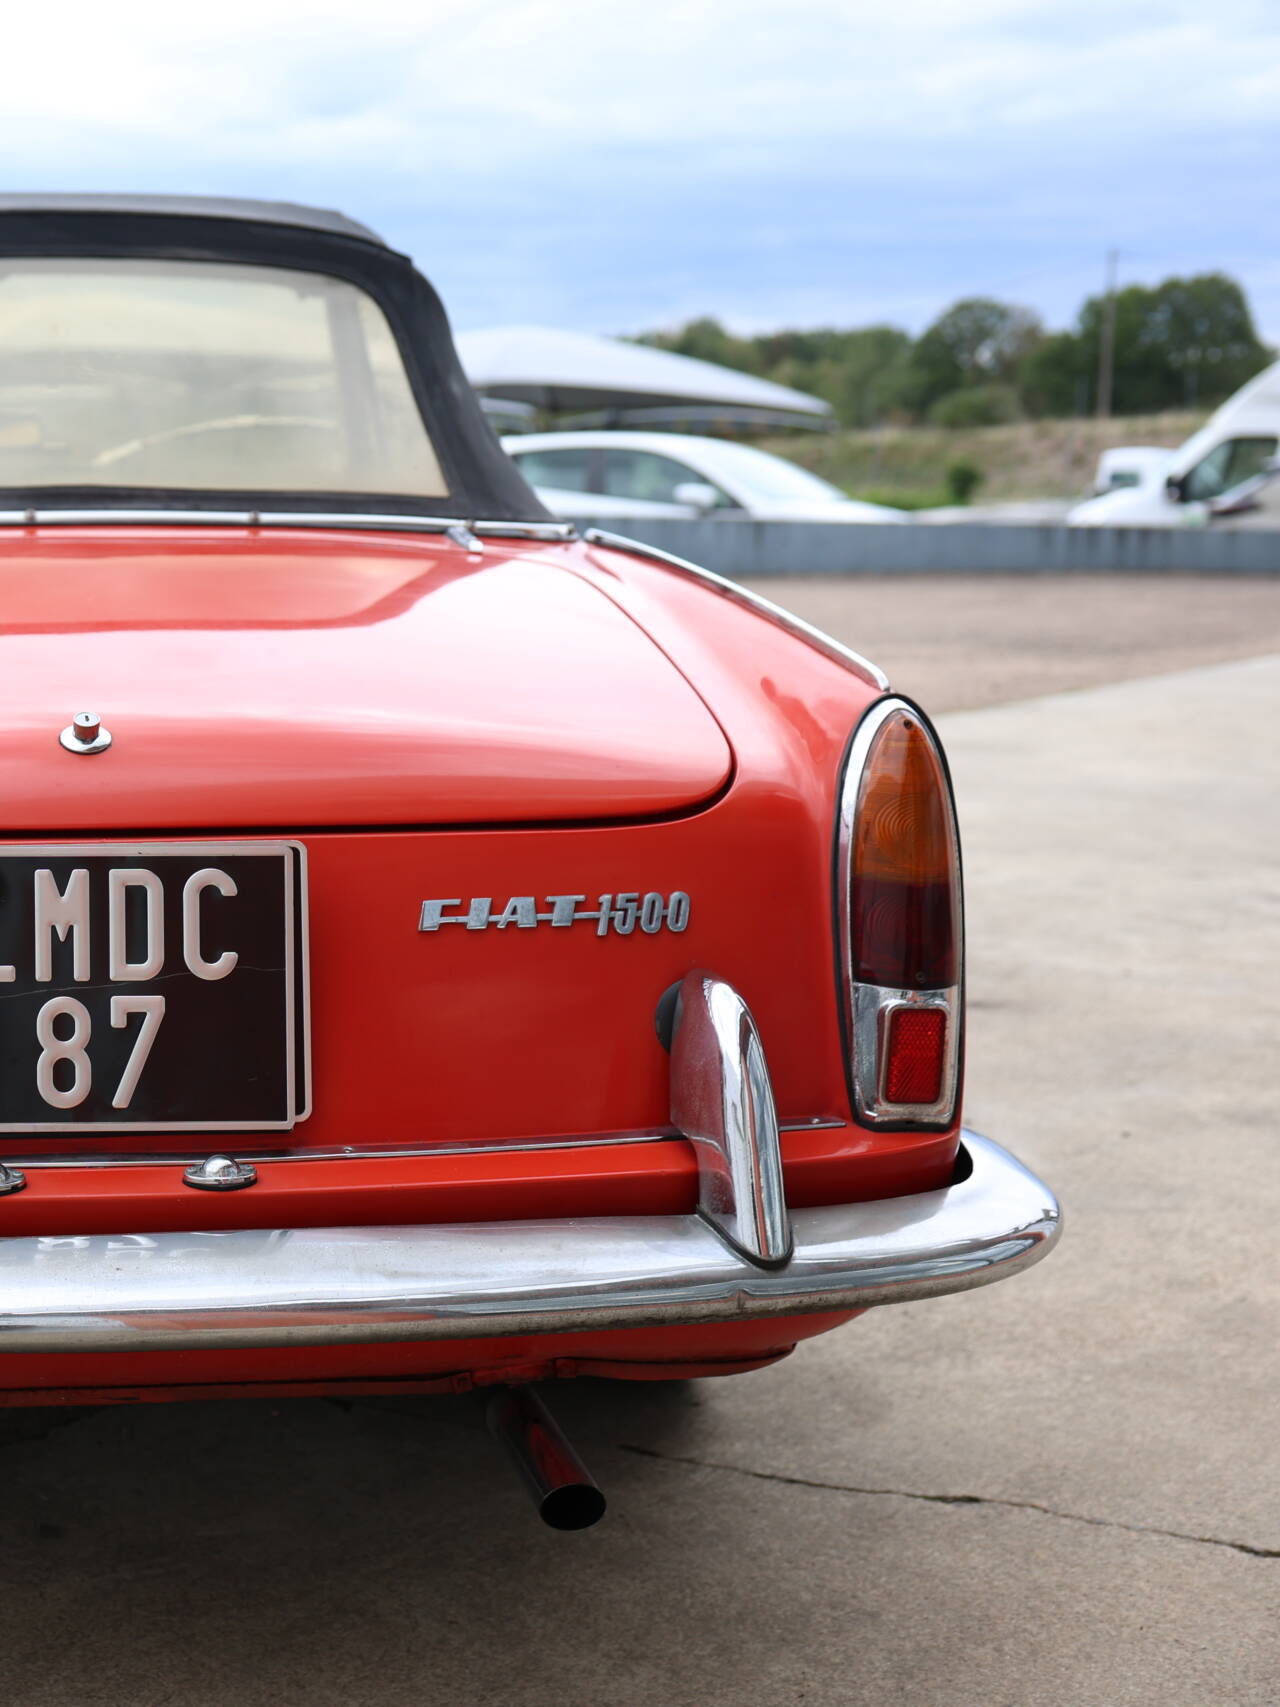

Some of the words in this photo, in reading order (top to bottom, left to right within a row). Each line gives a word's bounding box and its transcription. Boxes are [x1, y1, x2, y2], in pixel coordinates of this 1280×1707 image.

[418, 894, 586, 932] FIAT
[596, 891, 691, 937] 1500
[35, 995, 166, 1109] 87
